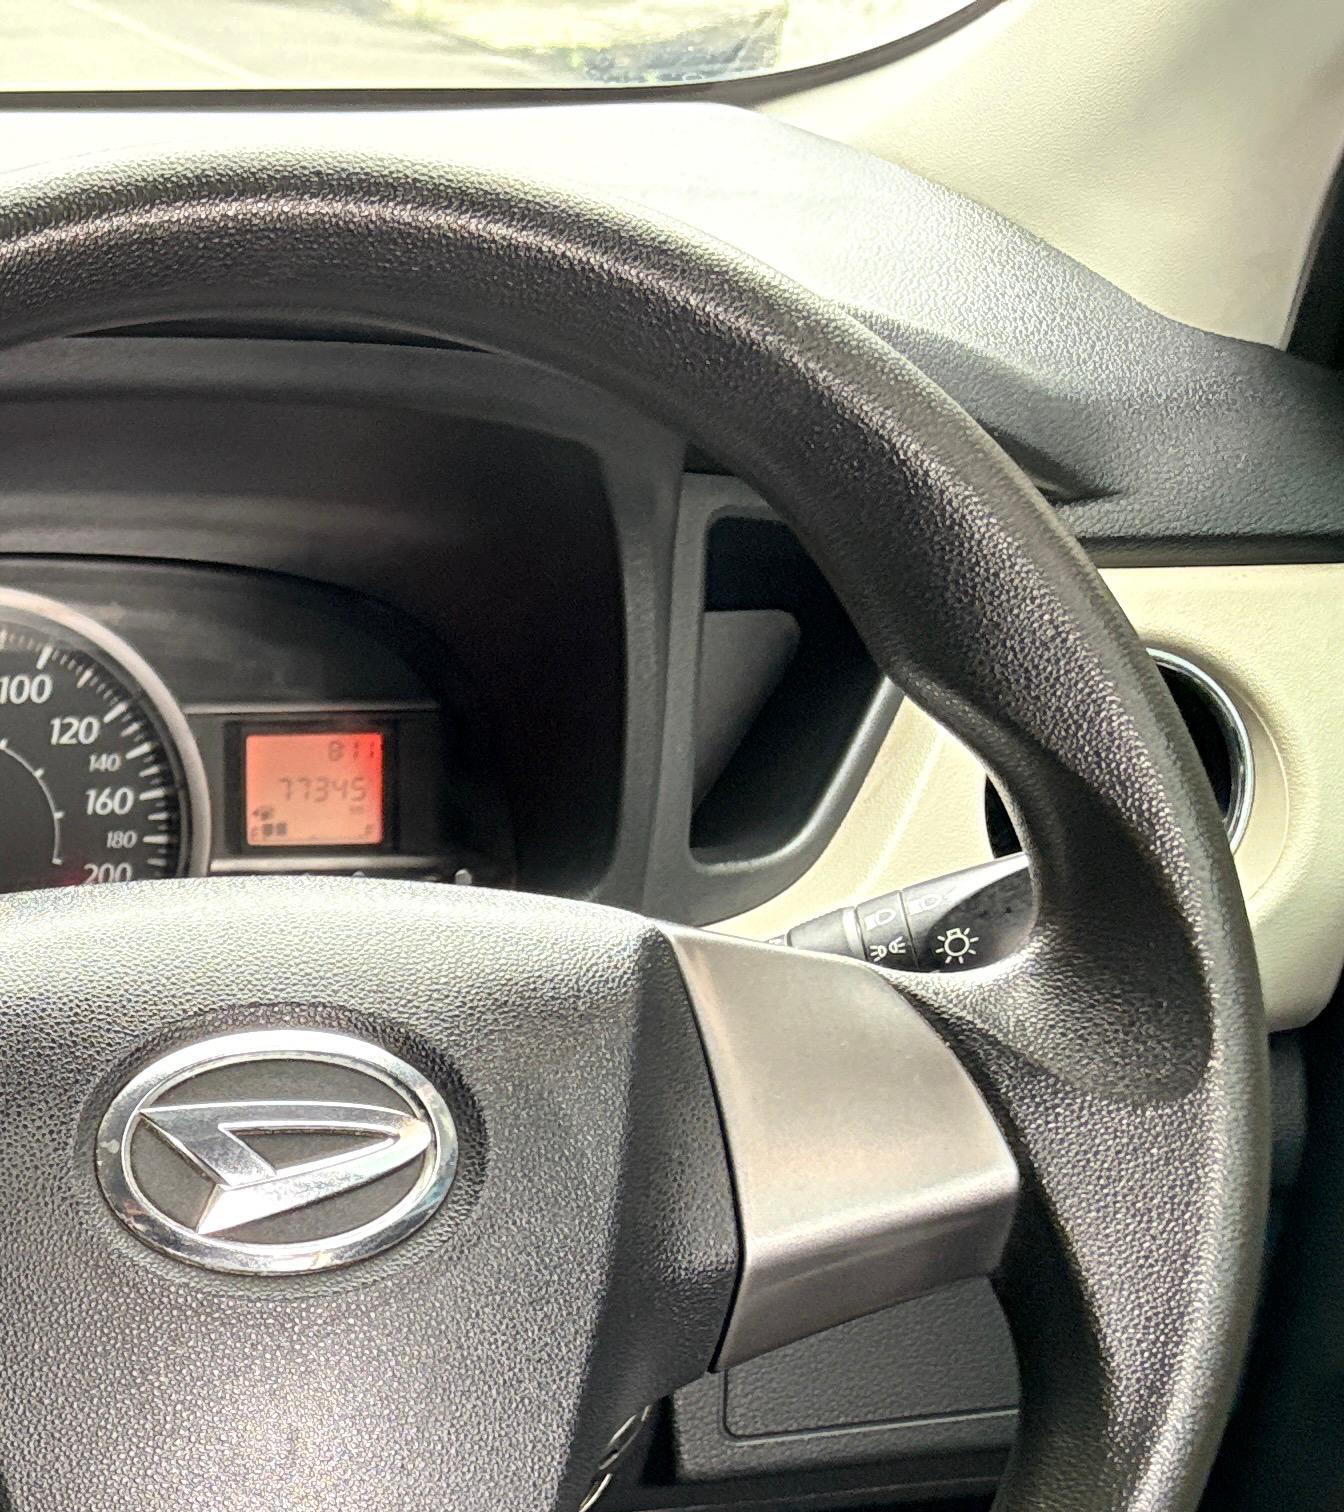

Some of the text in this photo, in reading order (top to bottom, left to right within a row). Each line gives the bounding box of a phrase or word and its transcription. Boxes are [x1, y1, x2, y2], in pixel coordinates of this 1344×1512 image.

[49, 716, 100, 745] 120
[89, 753, 122, 773] 140
[85, 786, 134, 815] 160
[280, 777, 367, 801] 77345
[106, 830, 138, 849] 180
[83, 863, 133, 885] 200
